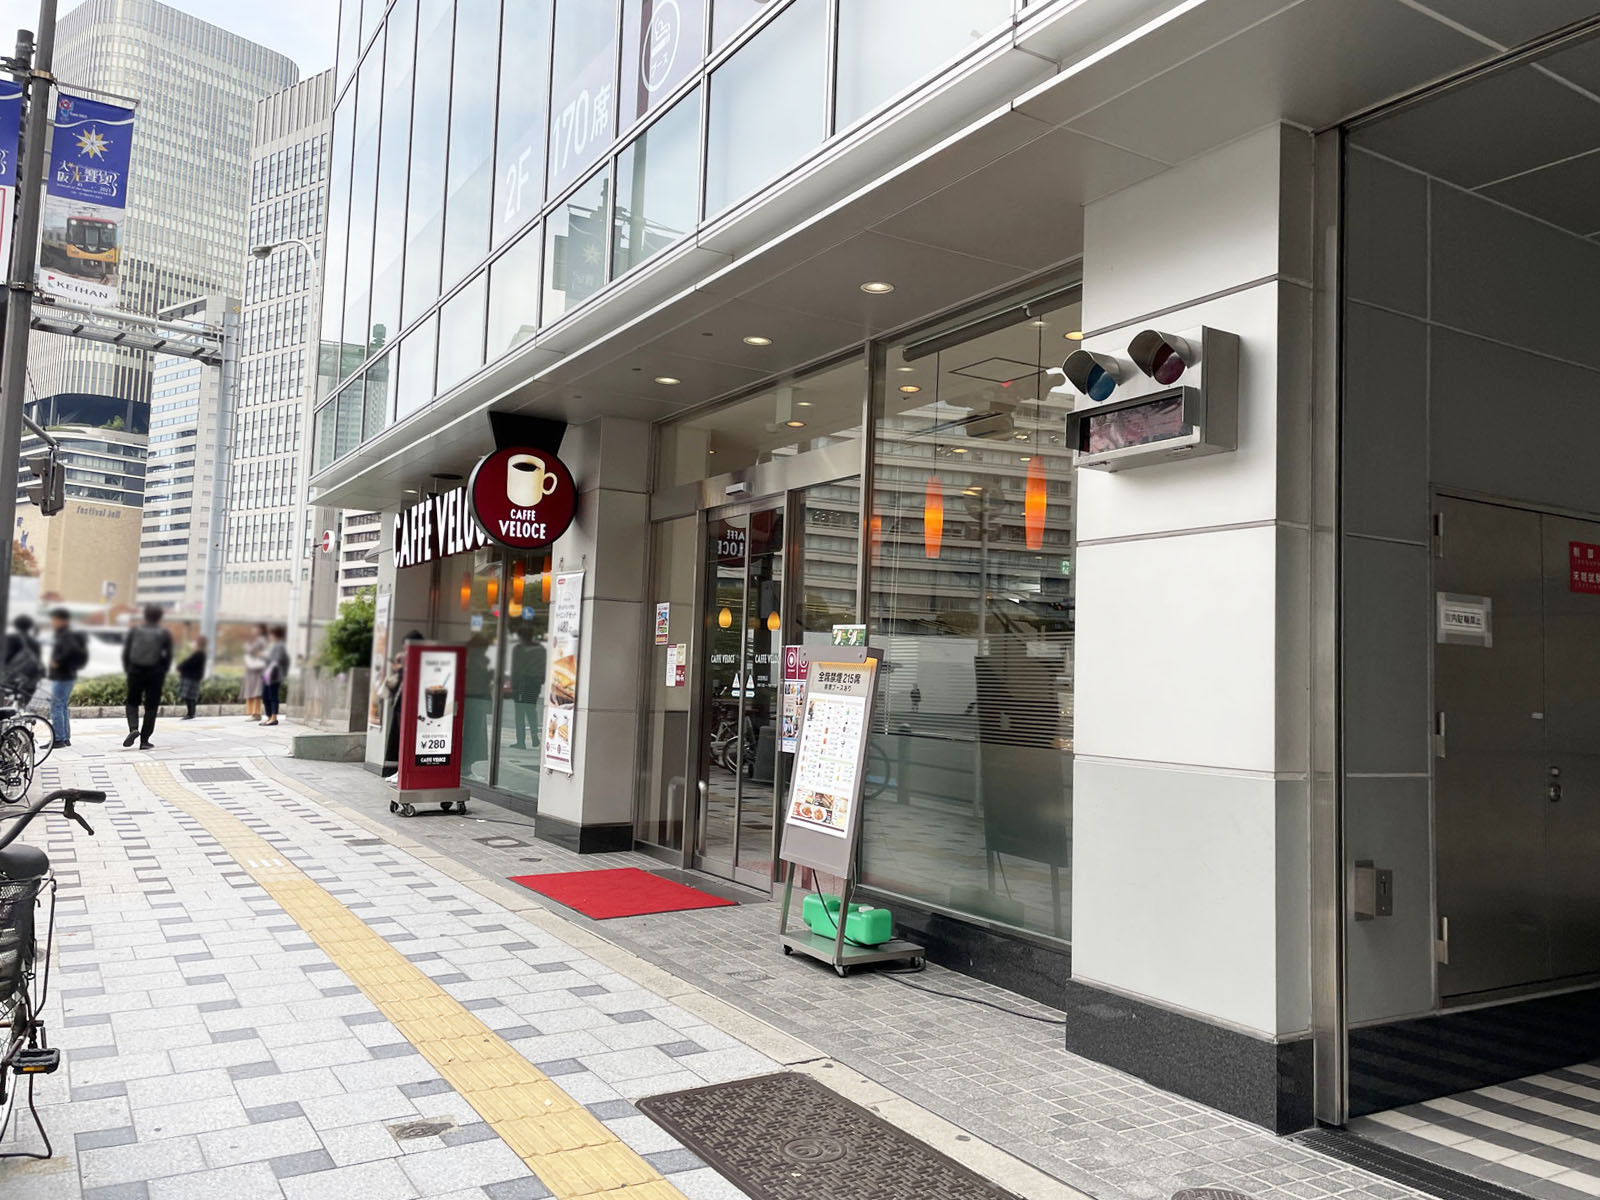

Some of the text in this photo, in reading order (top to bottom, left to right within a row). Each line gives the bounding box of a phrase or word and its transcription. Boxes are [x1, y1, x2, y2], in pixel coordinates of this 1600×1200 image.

[553, 83, 611, 177] 170席
[504, 146, 533, 223] 2F
[57, 281, 108, 299] KEIHAN
[436, 487, 494, 557] VELO
[498, 519, 547, 540] VELOCE
